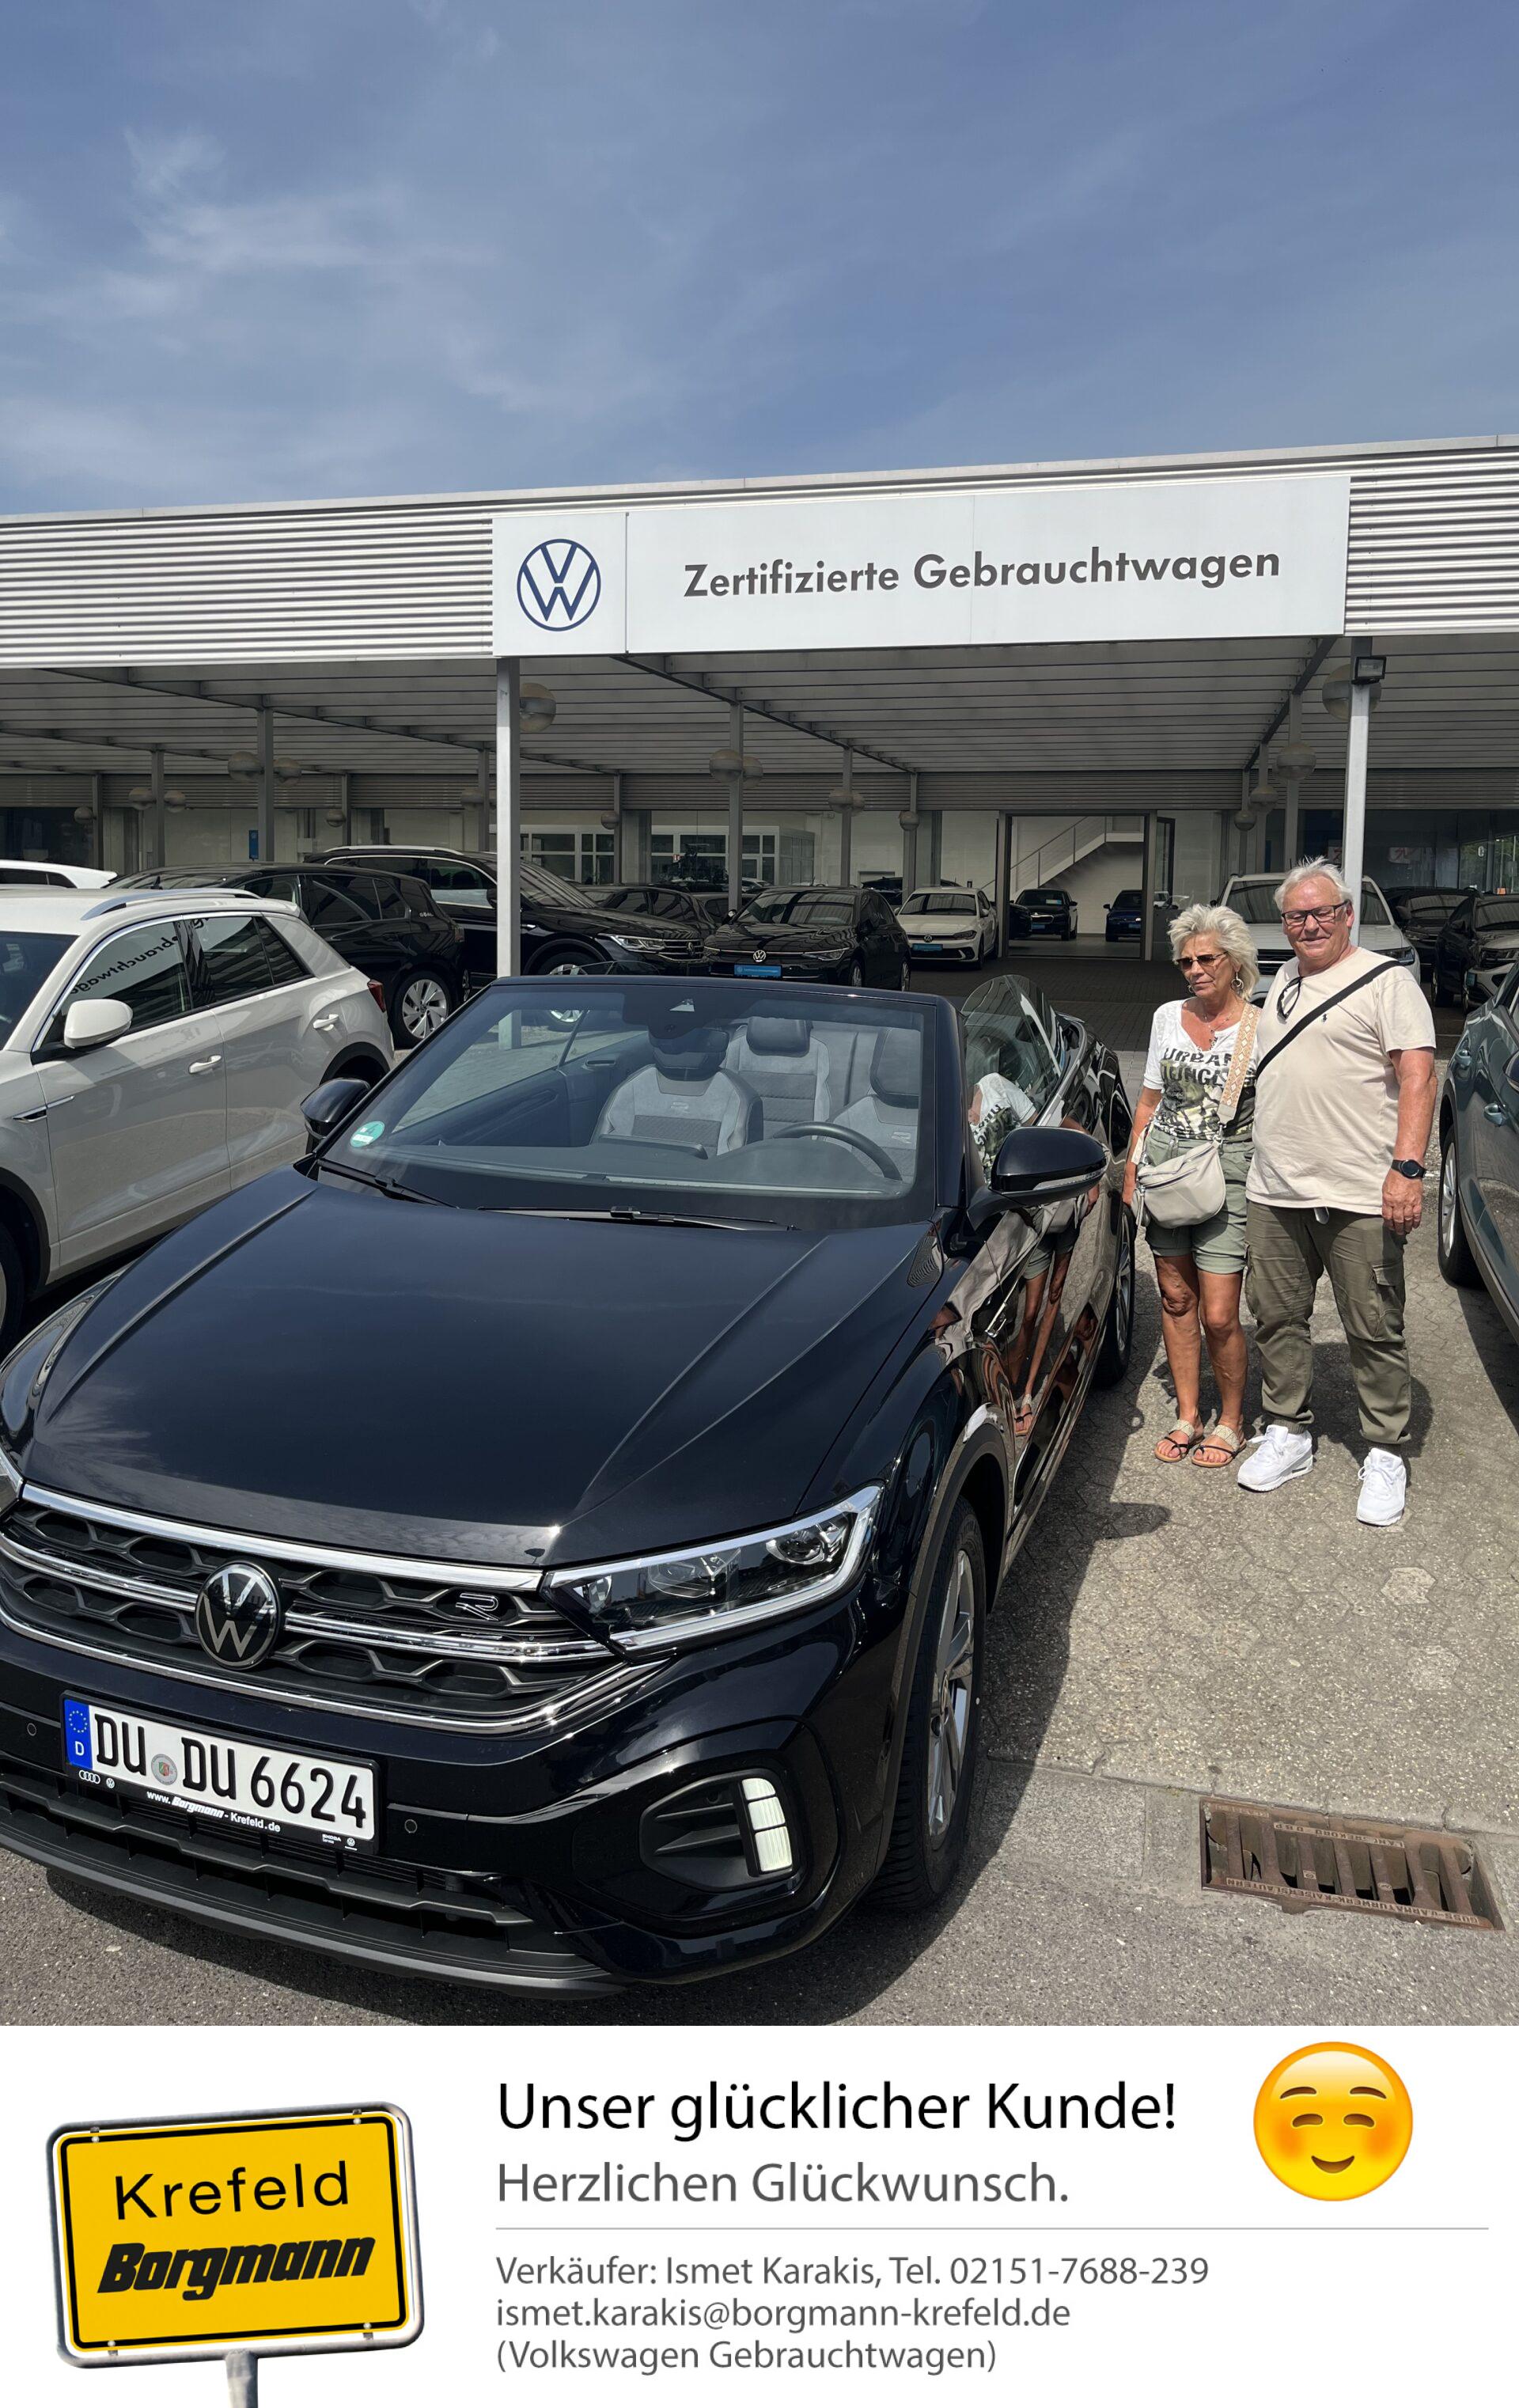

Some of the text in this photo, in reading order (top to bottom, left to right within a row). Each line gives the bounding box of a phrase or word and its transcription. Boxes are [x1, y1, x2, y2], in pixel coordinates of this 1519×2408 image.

[517, 539, 601, 632] VW
[684, 546, 1280, 597] Zertifizierte Gebrauchtwagen
[74, 1740, 85, 1756] D
[94, 1713, 147, 1777] DU
[181, 1737, 237, 1800] DU
[251, 1756, 366, 1828] 6624
